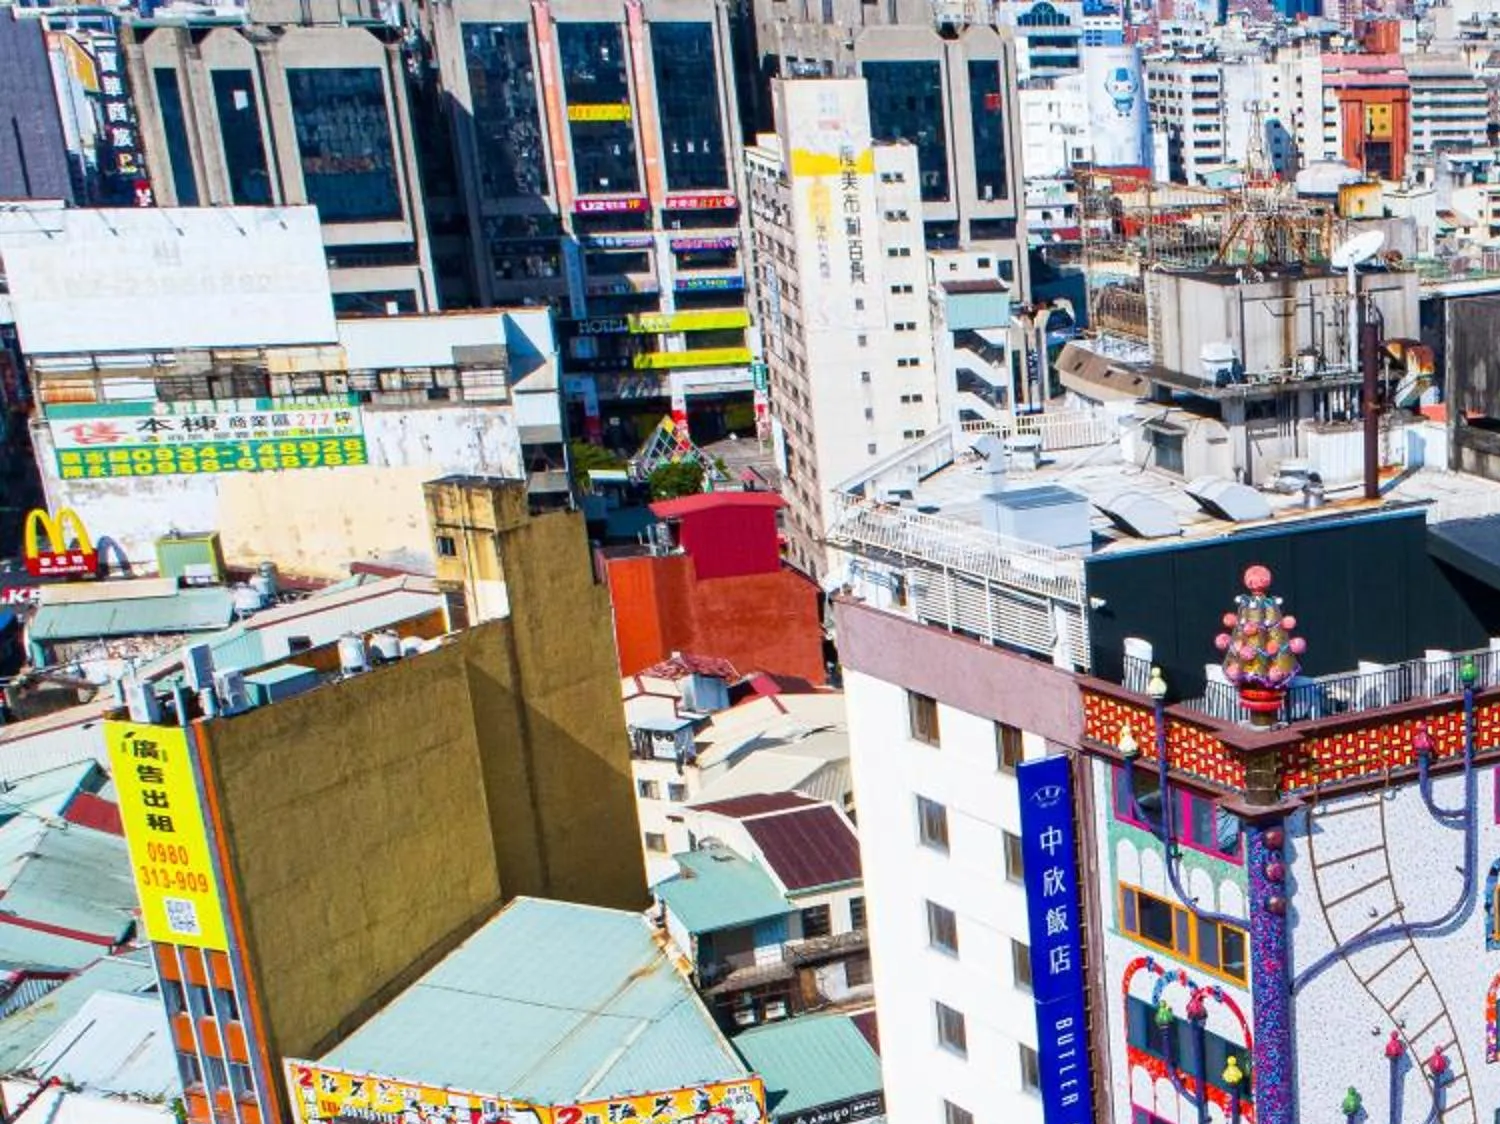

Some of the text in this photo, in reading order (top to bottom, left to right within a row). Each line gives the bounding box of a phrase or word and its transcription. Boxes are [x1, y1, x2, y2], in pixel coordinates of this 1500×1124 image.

[140, 865, 210, 894] 313-909
[147, 841, 190, 866] 0980
[1038, 825, 1072, 976] 中欣飯店
[1054, 1016, 1078, 1108] BUTLER
